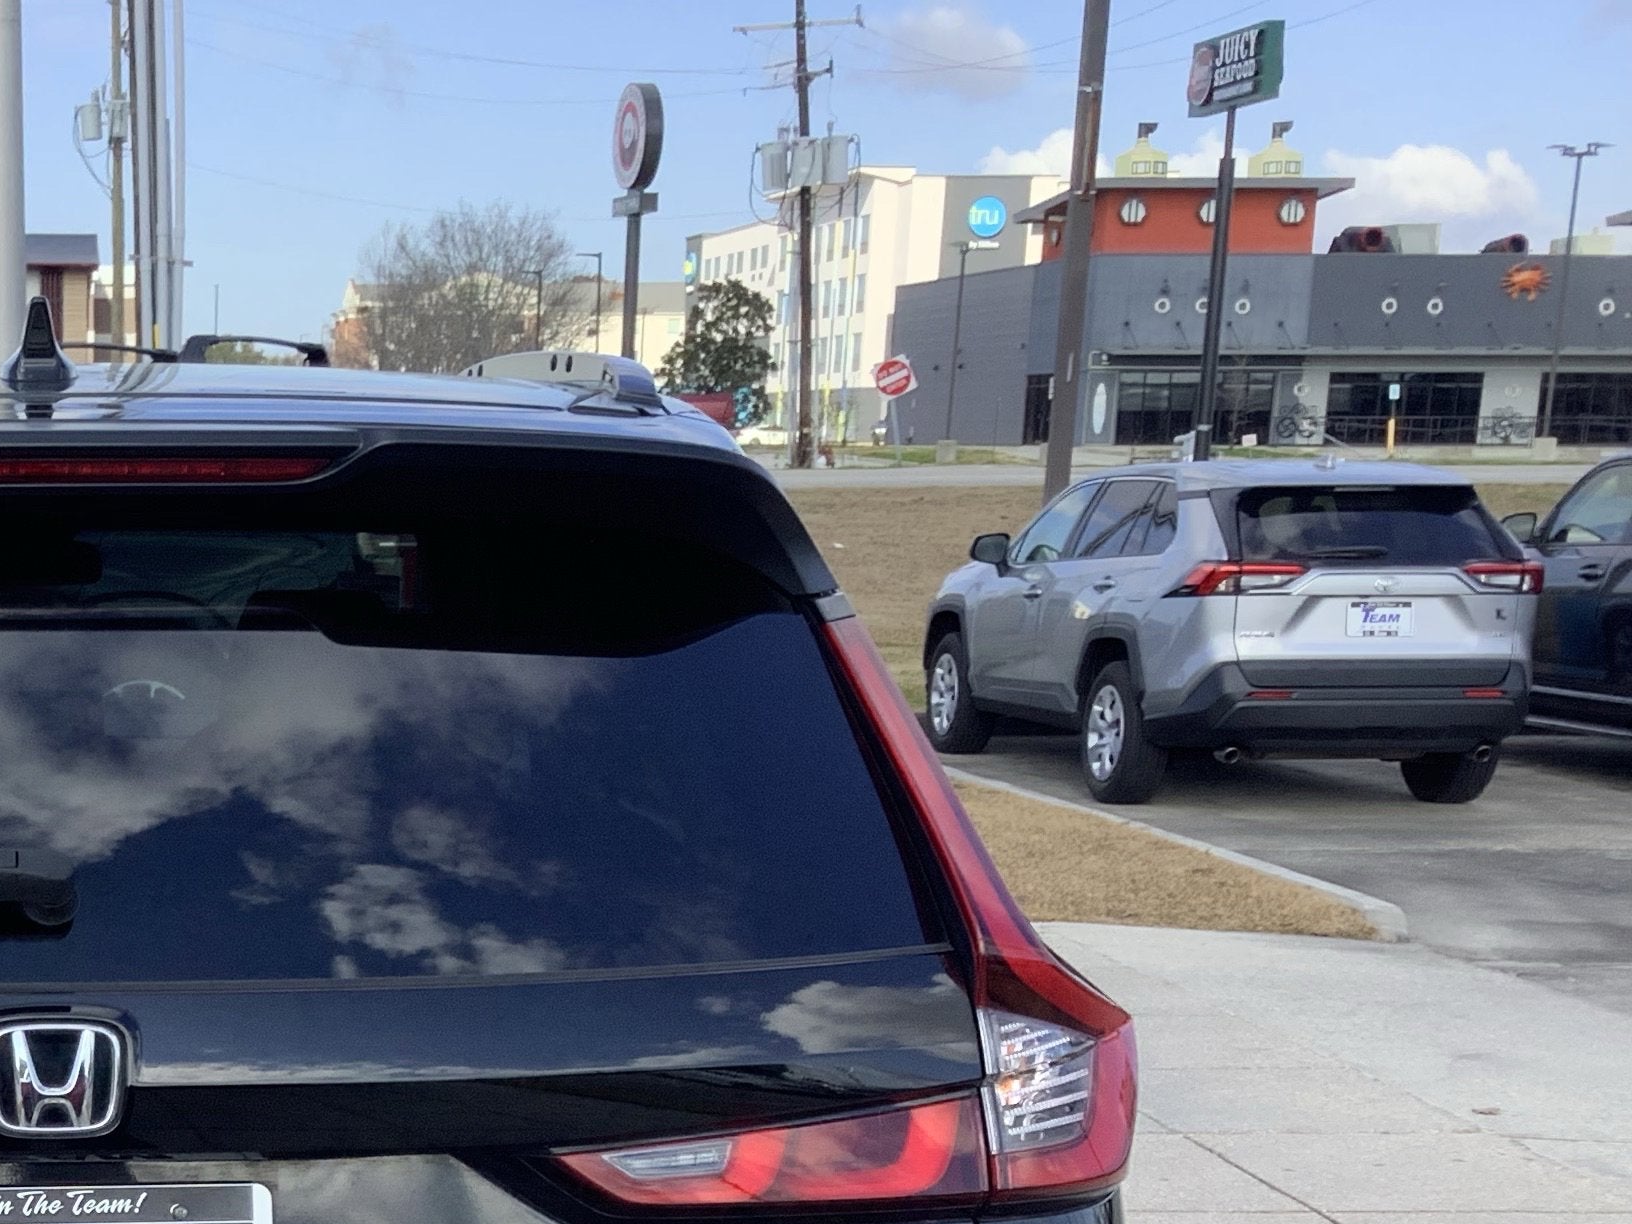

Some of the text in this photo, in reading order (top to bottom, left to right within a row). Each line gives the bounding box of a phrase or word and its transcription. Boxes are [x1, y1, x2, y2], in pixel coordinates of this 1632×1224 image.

[1215, 29, 1260, 67] JUICY
[1213, 58, 1257, 87] SEAFOOD
[969, 205, 1000, 225] tru
[1361, 603, 1401, 623] TEAM
[17, 1190, 64, 1216] The
[67, 1189, 148, 1216] Team!
